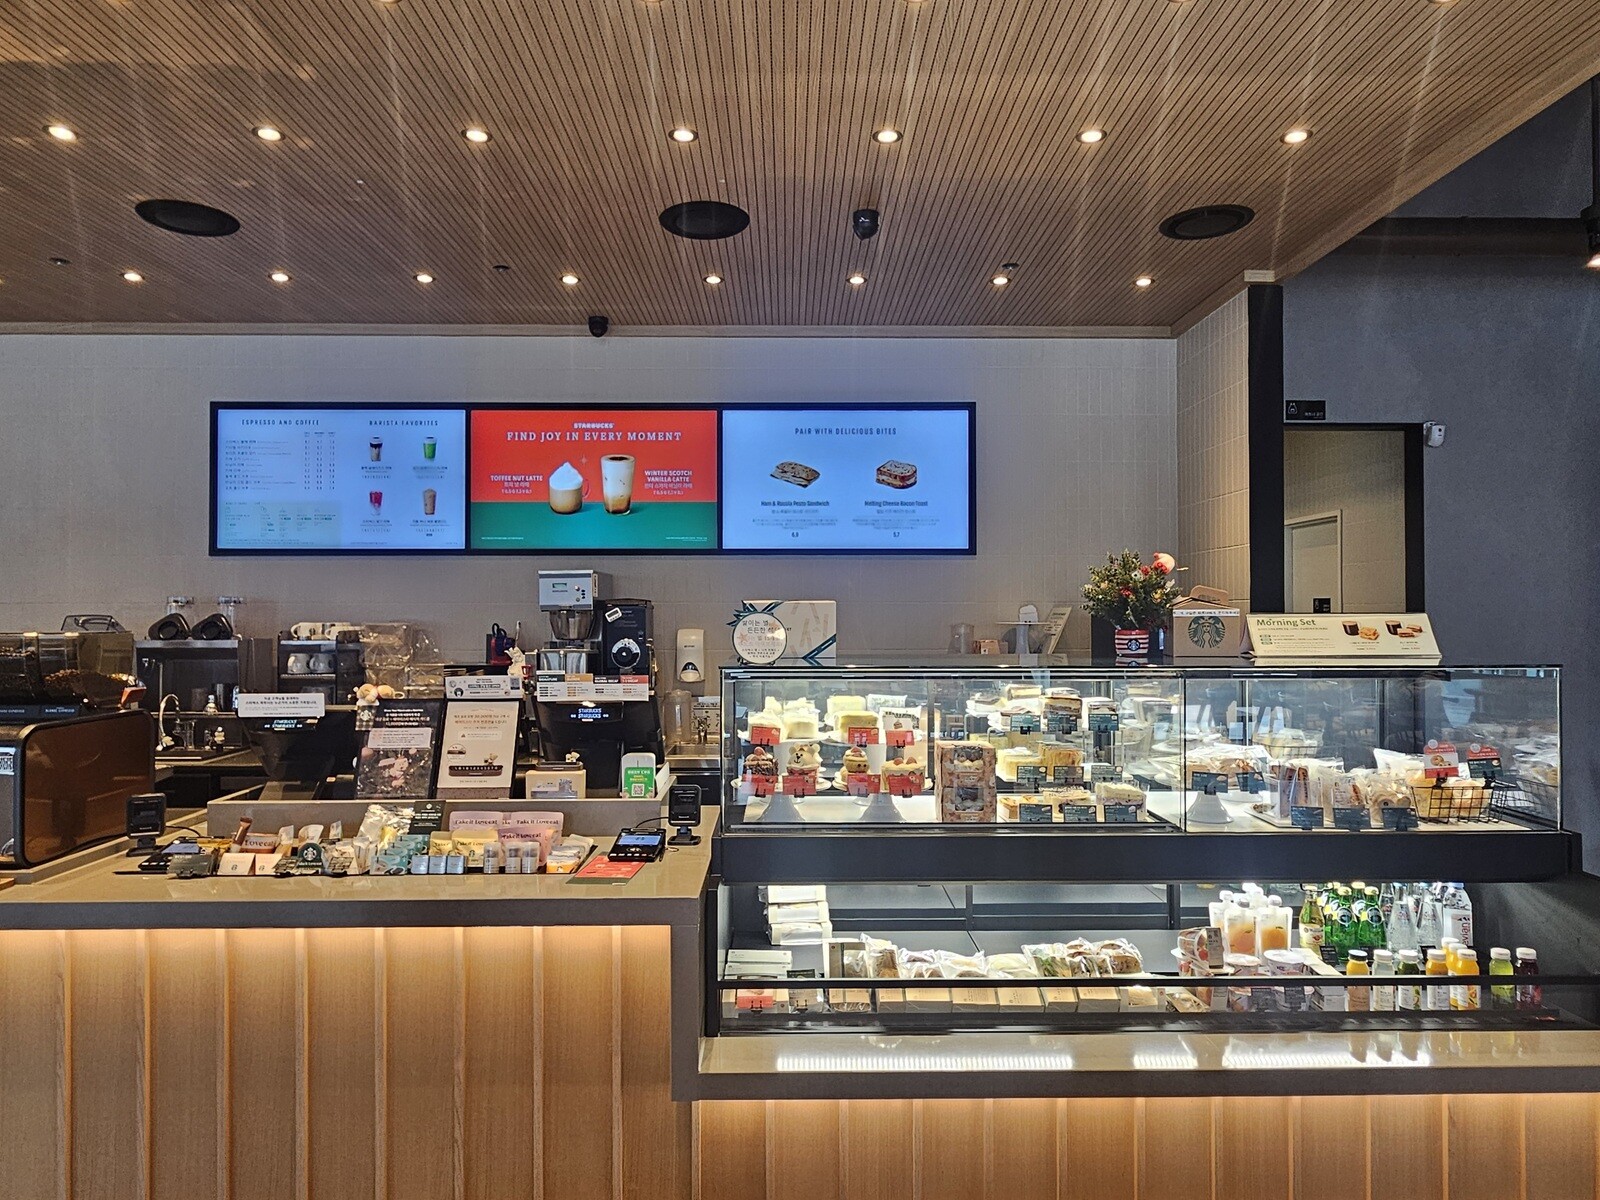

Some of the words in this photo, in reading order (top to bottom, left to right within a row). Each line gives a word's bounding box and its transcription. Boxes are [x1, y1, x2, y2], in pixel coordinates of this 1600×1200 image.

[794, 427, 812, 435] PAIR
[814, 427, 833, 435] WITH
[835, 427, 874, 435] DELICIOUS
[876, 427, 897, 435] BITES
[506, 432, 537, 441] FIND
[540, 432, 562, 443] JOY
[566, 432, 579, 441] IN
[584, 432, 623, 441] EVERY
[627, 432, 682, 441] MOMENT
[1256, 618, 1299, 627] Morning
[1299, 618, 1317, 626] Set
